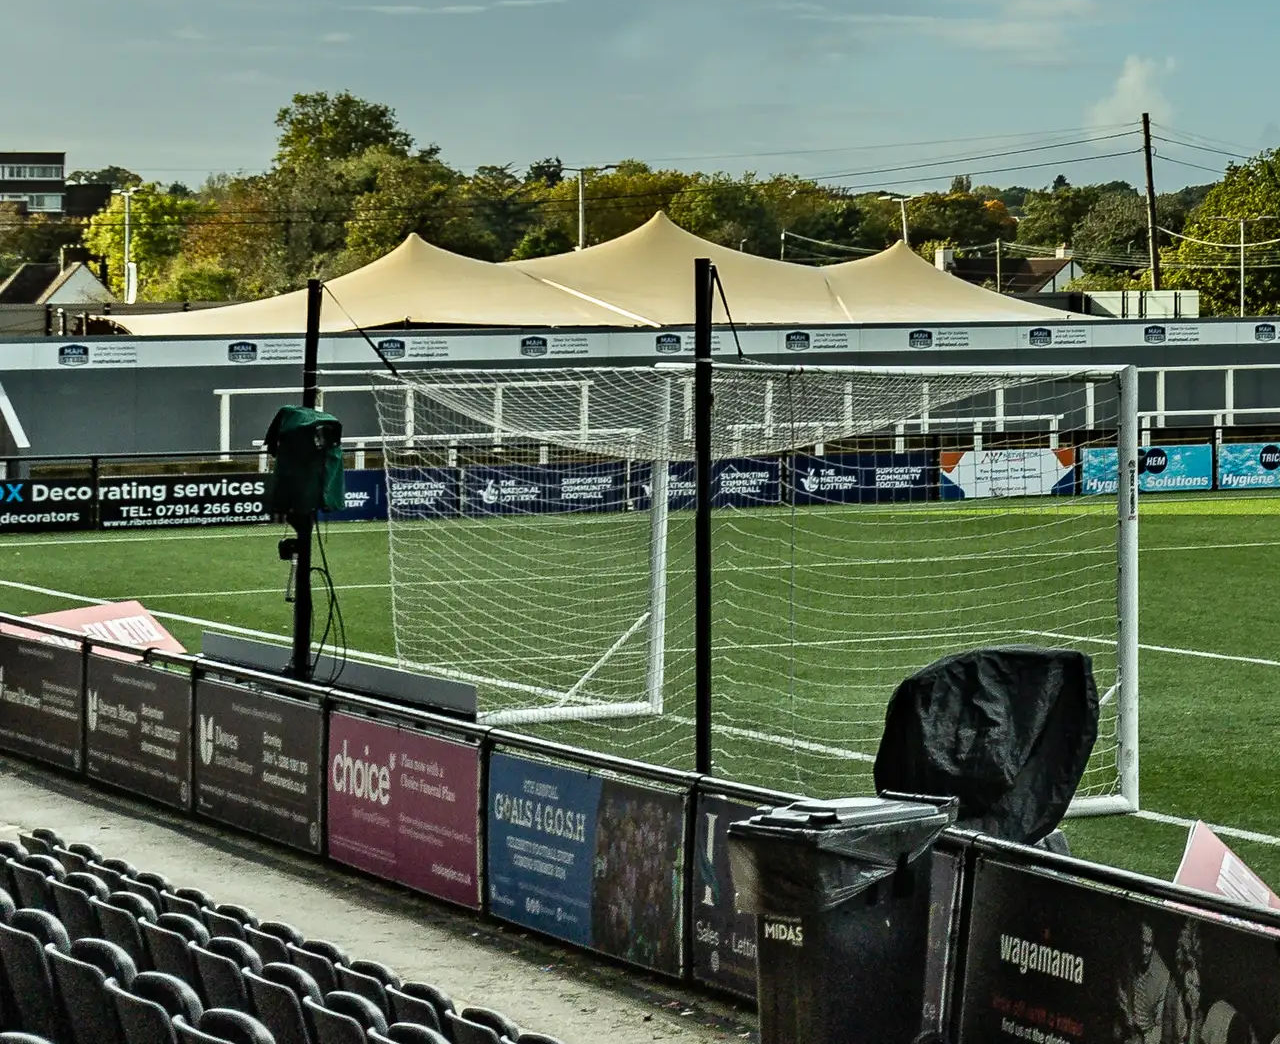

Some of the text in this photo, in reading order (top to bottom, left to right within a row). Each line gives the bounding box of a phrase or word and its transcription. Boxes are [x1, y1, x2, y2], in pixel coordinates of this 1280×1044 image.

[820, 468, 834, 476] THE
[876, 467, 922, 475] SUPPORTING
[561, 476, 613, 485] SUPPORTING
[720, 471, 770, 481] SUPPORTING
[876, 473, 921, 481] COMMUNITY
[1222, 472, 1275, 487] Hygiene
[391, 481, 446, 491] SUPPORTING
[720, 479, 767, 487] COMMUNITY
[876, 480, 914, 488] FOOTBALL
[1146, 475, 1208, 488] Solutions
[173, 479, 265, 498] services
[561, 484, 612, 493] COMMUNITY
[720, 486, 761, 494] FOOTBALL
[819, 482, 853, 491] LOTTERY
[391, 489, 444, 498] COMMUNITY
[561, 492, 603, 500] FOOTBALL
[344, 499, 365, 508] TERY
[391, 497, 436, 506] FOOTBALL
[120, 501, 263, 518] TEL: 07914 266 690
[332, 739, 390, 806] choice
[494, 792, 533, 828] GOALS
[534, 802, 542, 831] 4
[696, 920, 720, 946] Sales
[764, 922, 803, 942] MIDAS
[1000, 933, 1084, 985] wagamama
